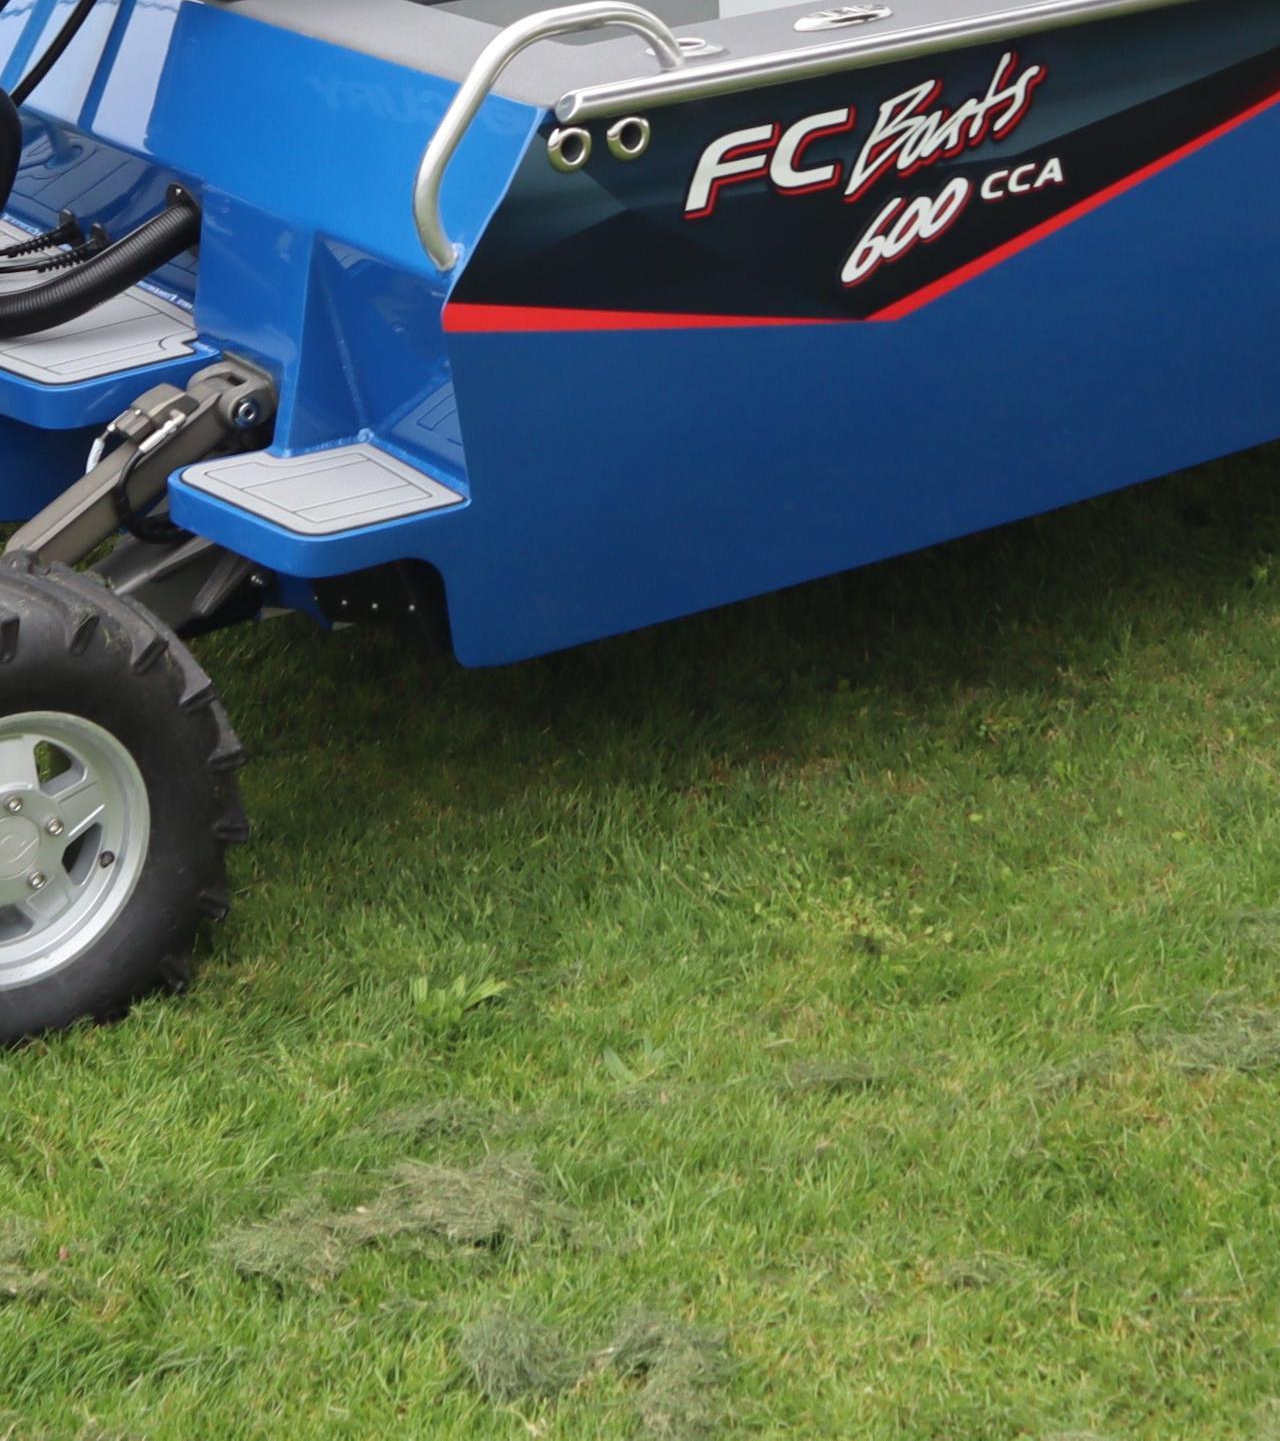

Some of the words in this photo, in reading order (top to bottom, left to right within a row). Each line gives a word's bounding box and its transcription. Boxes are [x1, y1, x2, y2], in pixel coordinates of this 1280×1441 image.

[684, 108, 854, 217] FC
[840, 176, 972, 286] 600
[980, 157, 1064, 201] CCA
